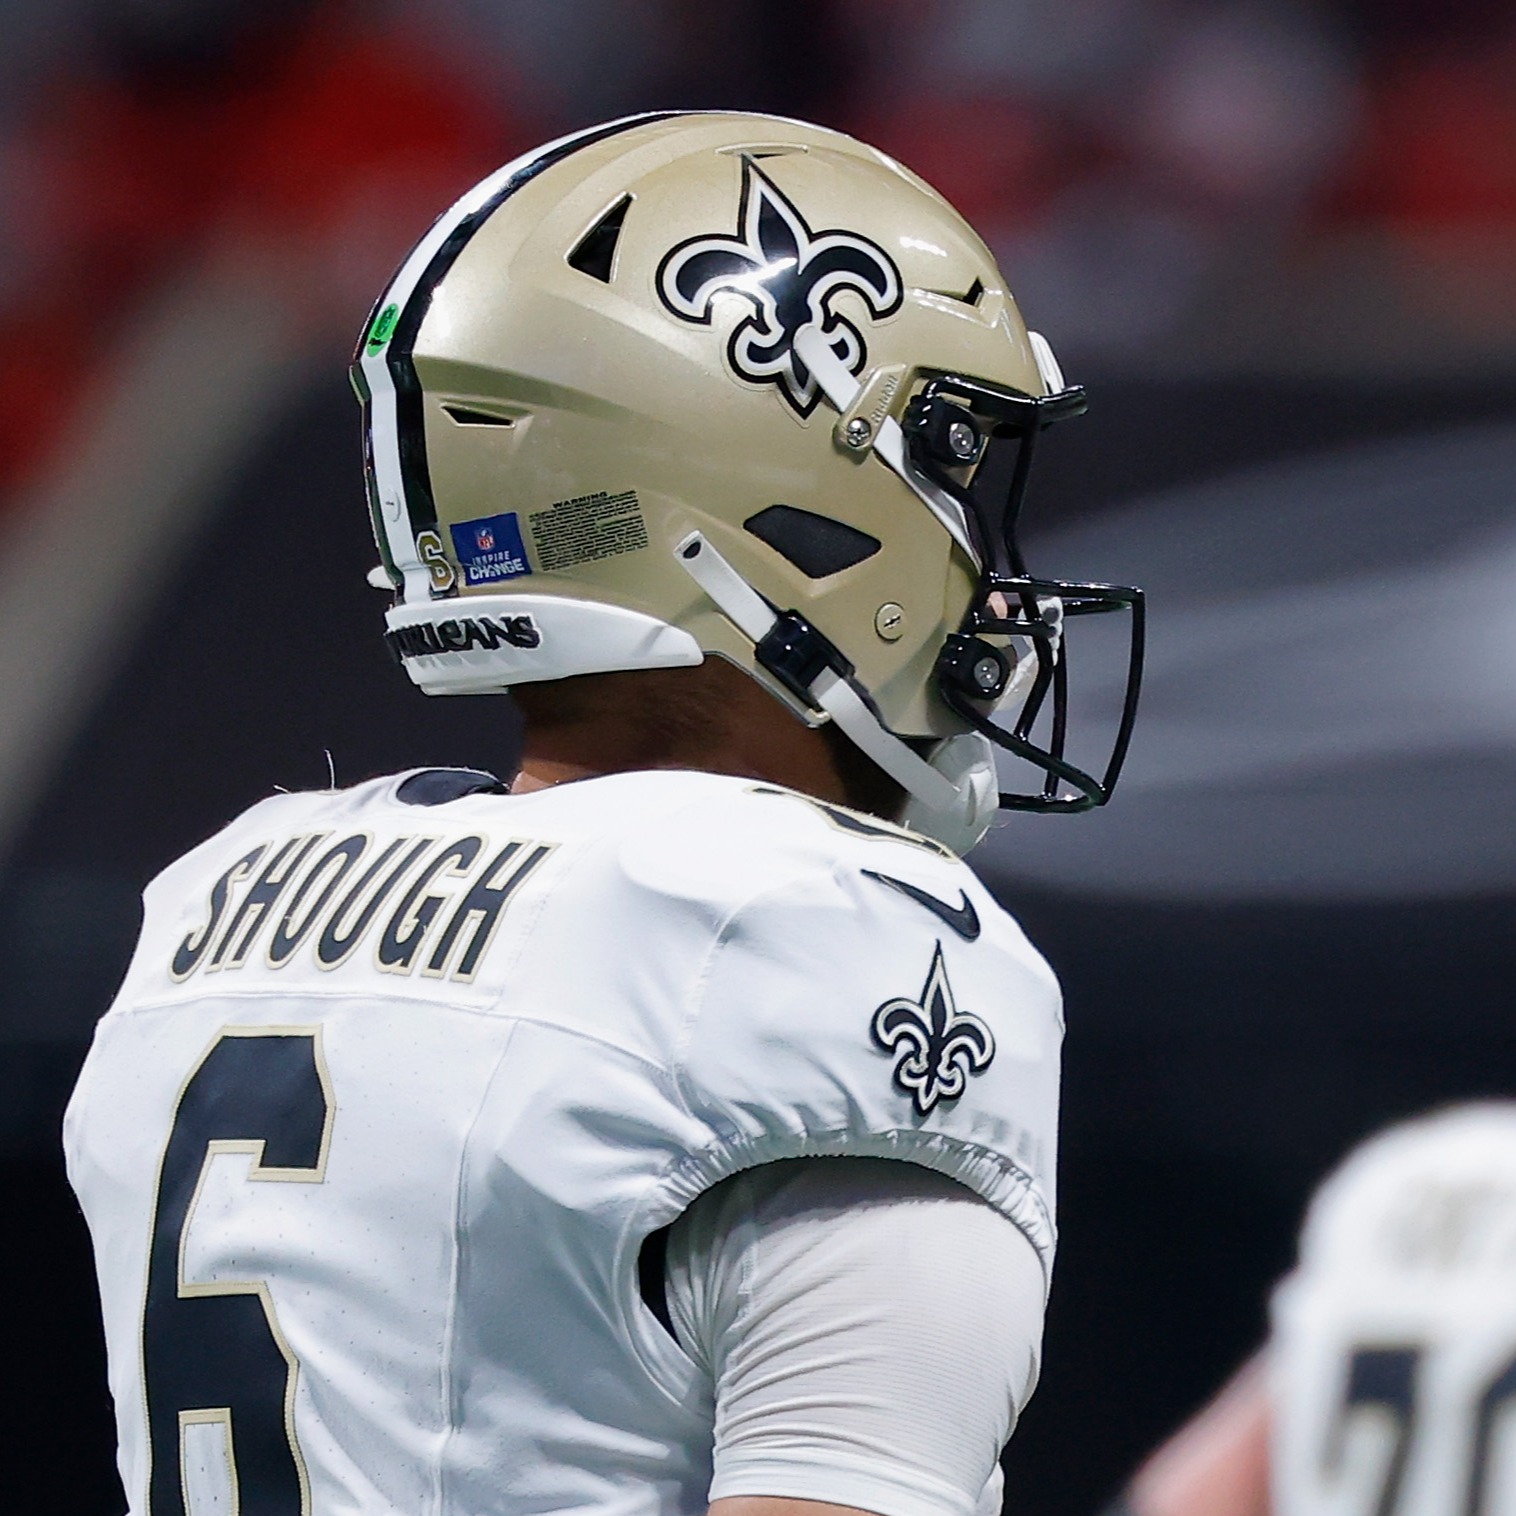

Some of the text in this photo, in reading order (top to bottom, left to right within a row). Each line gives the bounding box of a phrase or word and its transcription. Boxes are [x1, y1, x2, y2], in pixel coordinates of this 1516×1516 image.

[552, 490, 608, 509] WARNING
[469, 557, 525, 581] CHANGE
[168, 828, 561, 985] SHOUGH
